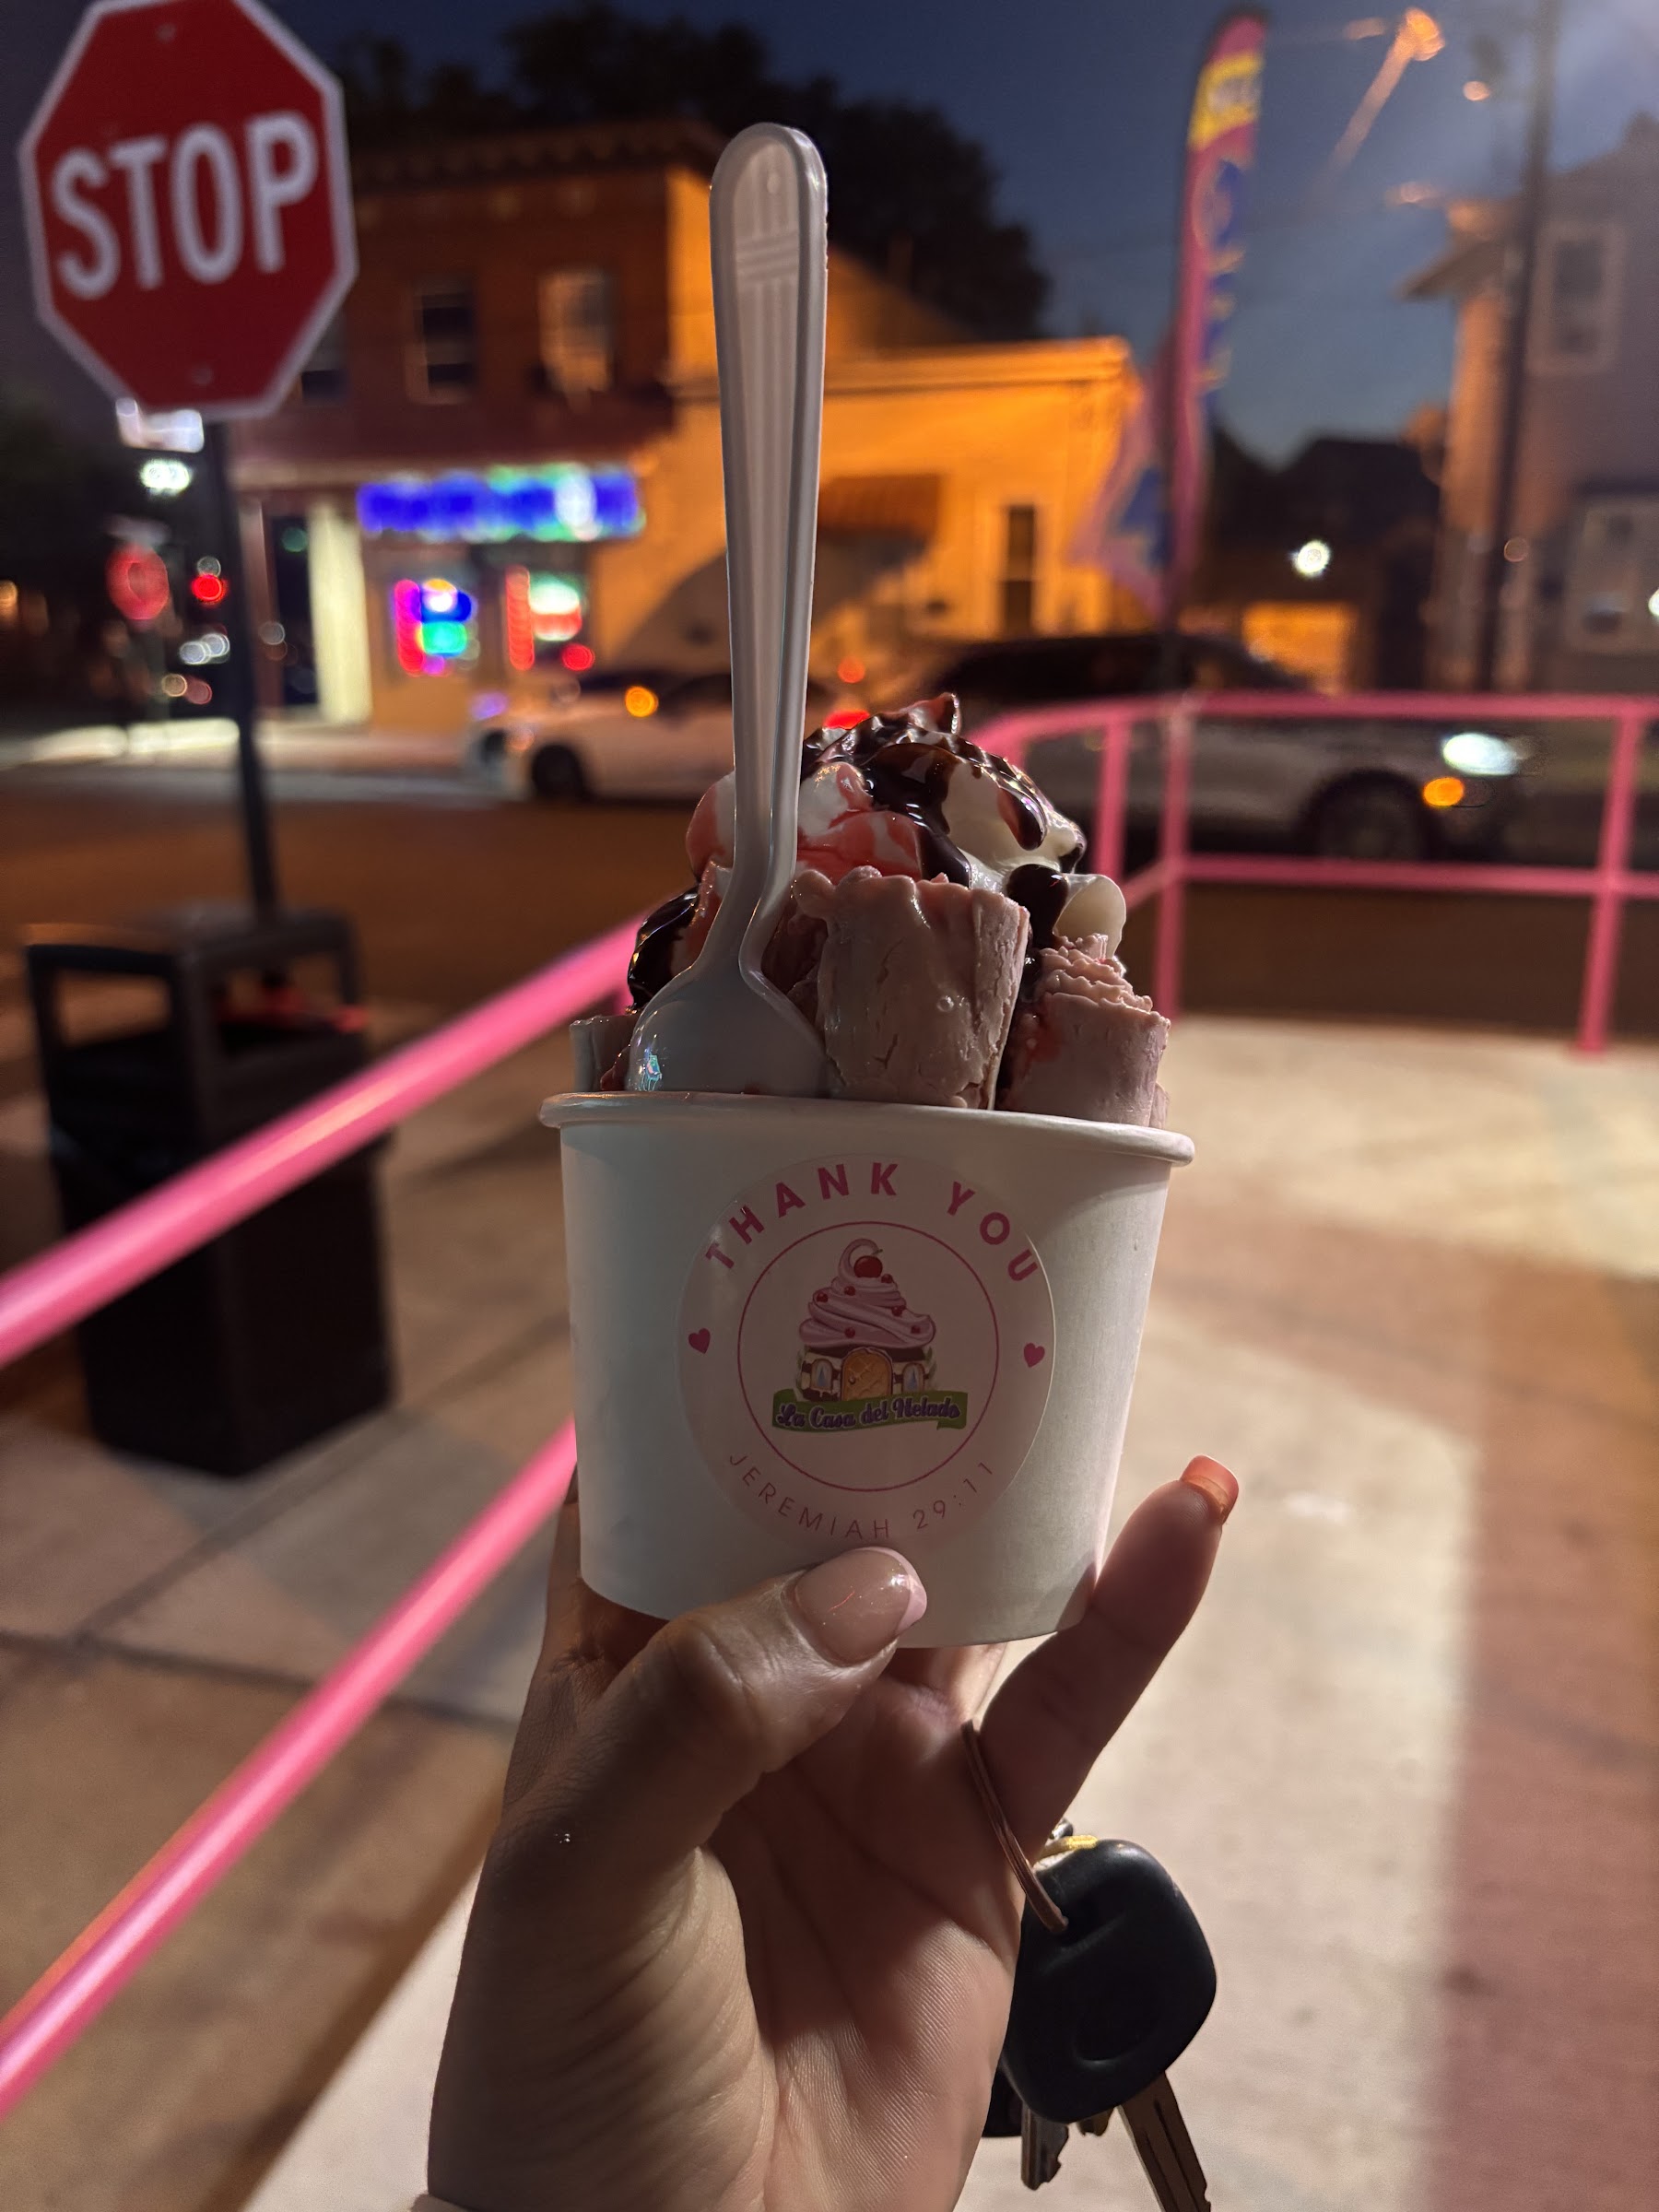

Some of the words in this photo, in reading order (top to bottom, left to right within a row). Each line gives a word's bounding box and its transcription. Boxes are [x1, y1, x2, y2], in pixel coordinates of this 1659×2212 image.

[52, 110, 319, 300] STOP
[705, 1161, 899, 1270] THANK
[947, 1181, 1039, 1282] YOU
[776, 1403, 806, 1428] La
[809, 1407, 856, 1430] Casa
[861, 1399, 889, 1424] del
[892, 1395, 961, 1420] Helado
[728, 1452, 890, 1540] JEREMIAH
[912, 1461, 994, 1530] 29:11
